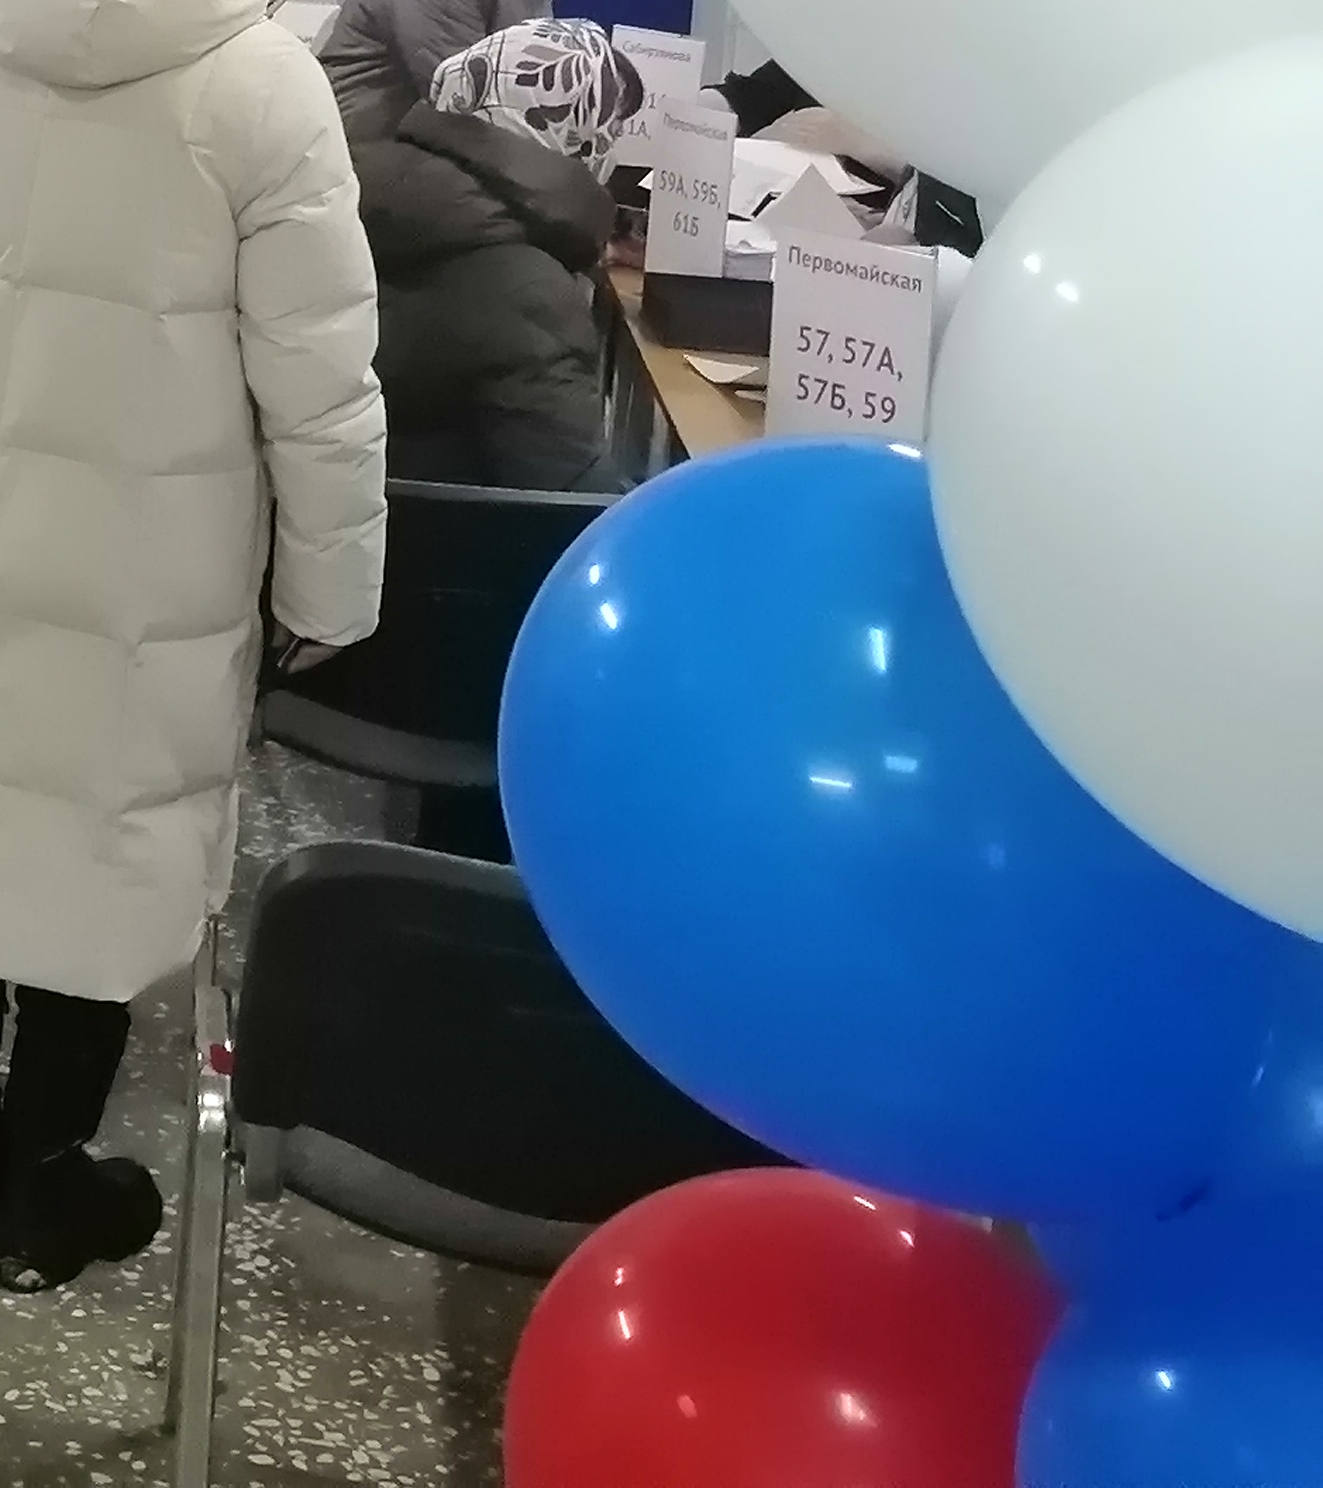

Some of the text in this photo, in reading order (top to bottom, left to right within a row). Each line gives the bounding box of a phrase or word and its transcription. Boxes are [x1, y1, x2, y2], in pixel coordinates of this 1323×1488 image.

[659, 169, 721, 209] 59А, 59Б,
[673, 212, 699, 237] 61Б
[788, 245, 923, 293] Первомайская
[796, 325, 903, 382] 57, 57А,
[796, 373, 896, 423] 57Б, 59
